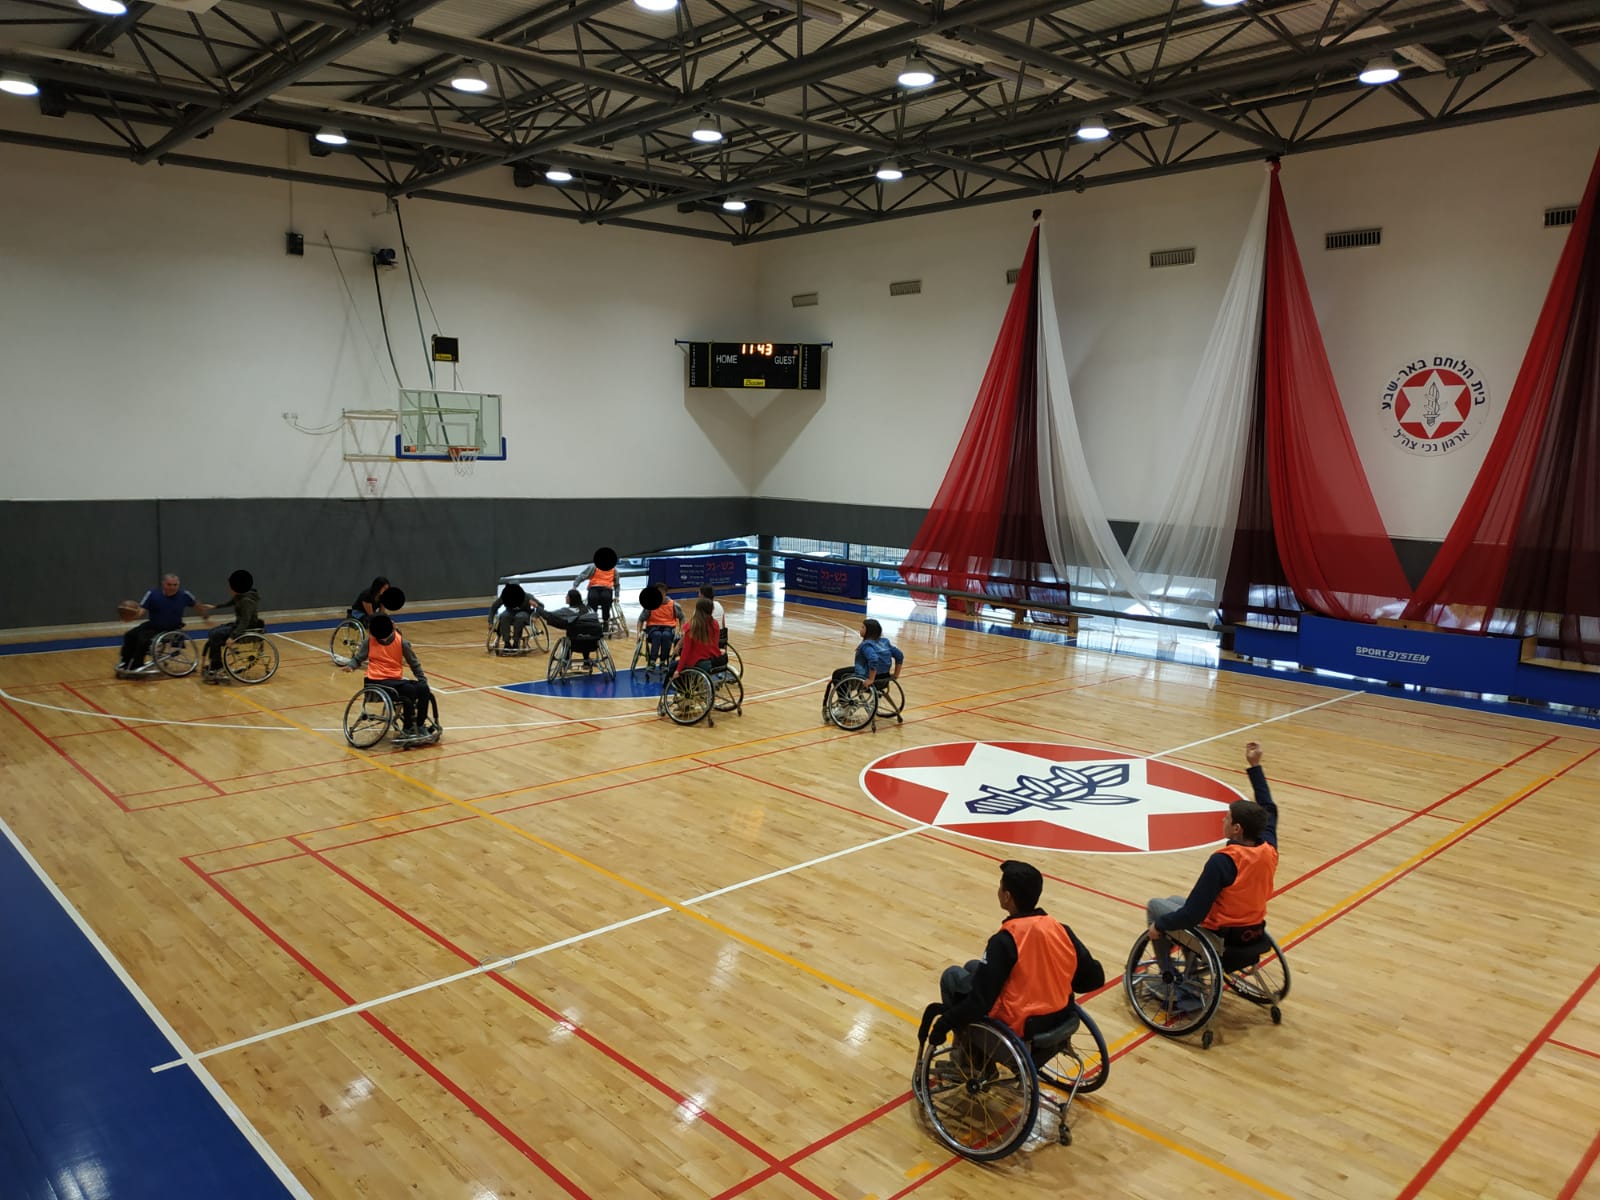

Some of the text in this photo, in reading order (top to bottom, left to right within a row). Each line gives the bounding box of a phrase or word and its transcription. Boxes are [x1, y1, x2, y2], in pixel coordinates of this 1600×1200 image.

[716, 354, 738, 364] HOME
[774, 355, 796, 365] GUEST
[1381, 356, 1486, 410] בית הלוחם באר-שבע
[1442, 429, 1470, 452] ארגון
[1421, 443, 1438, 452] נכי
